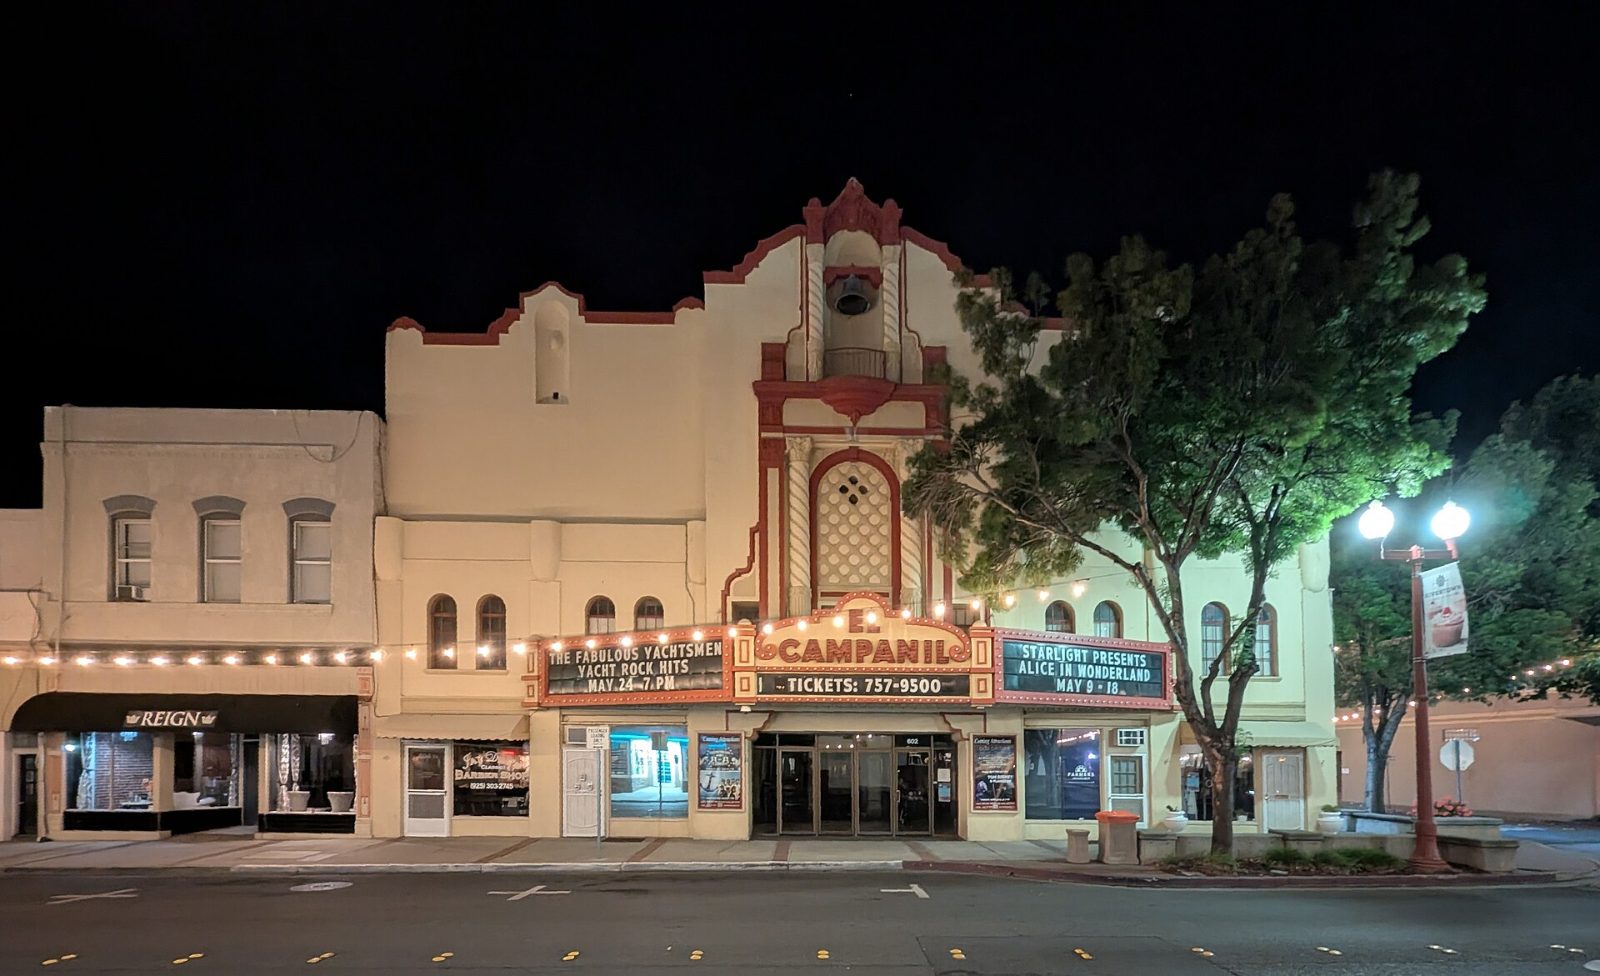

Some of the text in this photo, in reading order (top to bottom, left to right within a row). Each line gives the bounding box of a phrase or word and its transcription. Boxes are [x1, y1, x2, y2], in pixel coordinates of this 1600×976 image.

[849, 609, 881, 633] EL
[550, 642, 722, 665] THE FABULOUS YACHTSMEN
[779, 638, 950, 664] CAMPANIL
[1022, 644, 1147, 667] STARLIGHT PRESENTS
[578, 659, 689, 678] YACHT ROCK HITS
[1018, 660, 1151, 682] ALICE IN WONDERLAND
[588, 675, 675, 692] MAY 24 7 PM
[787, 677, 859, 693] TICKETS:
[864, 678, 941, 694] 757-9500
[1056, 678, 1083, 693] MAY
[1086, 680, 1094, 694] 9
[1106, 681, 1119, 695] 18
[140, 711, 202, 726] REIGN
[470, 782, 486, 790] (925)
